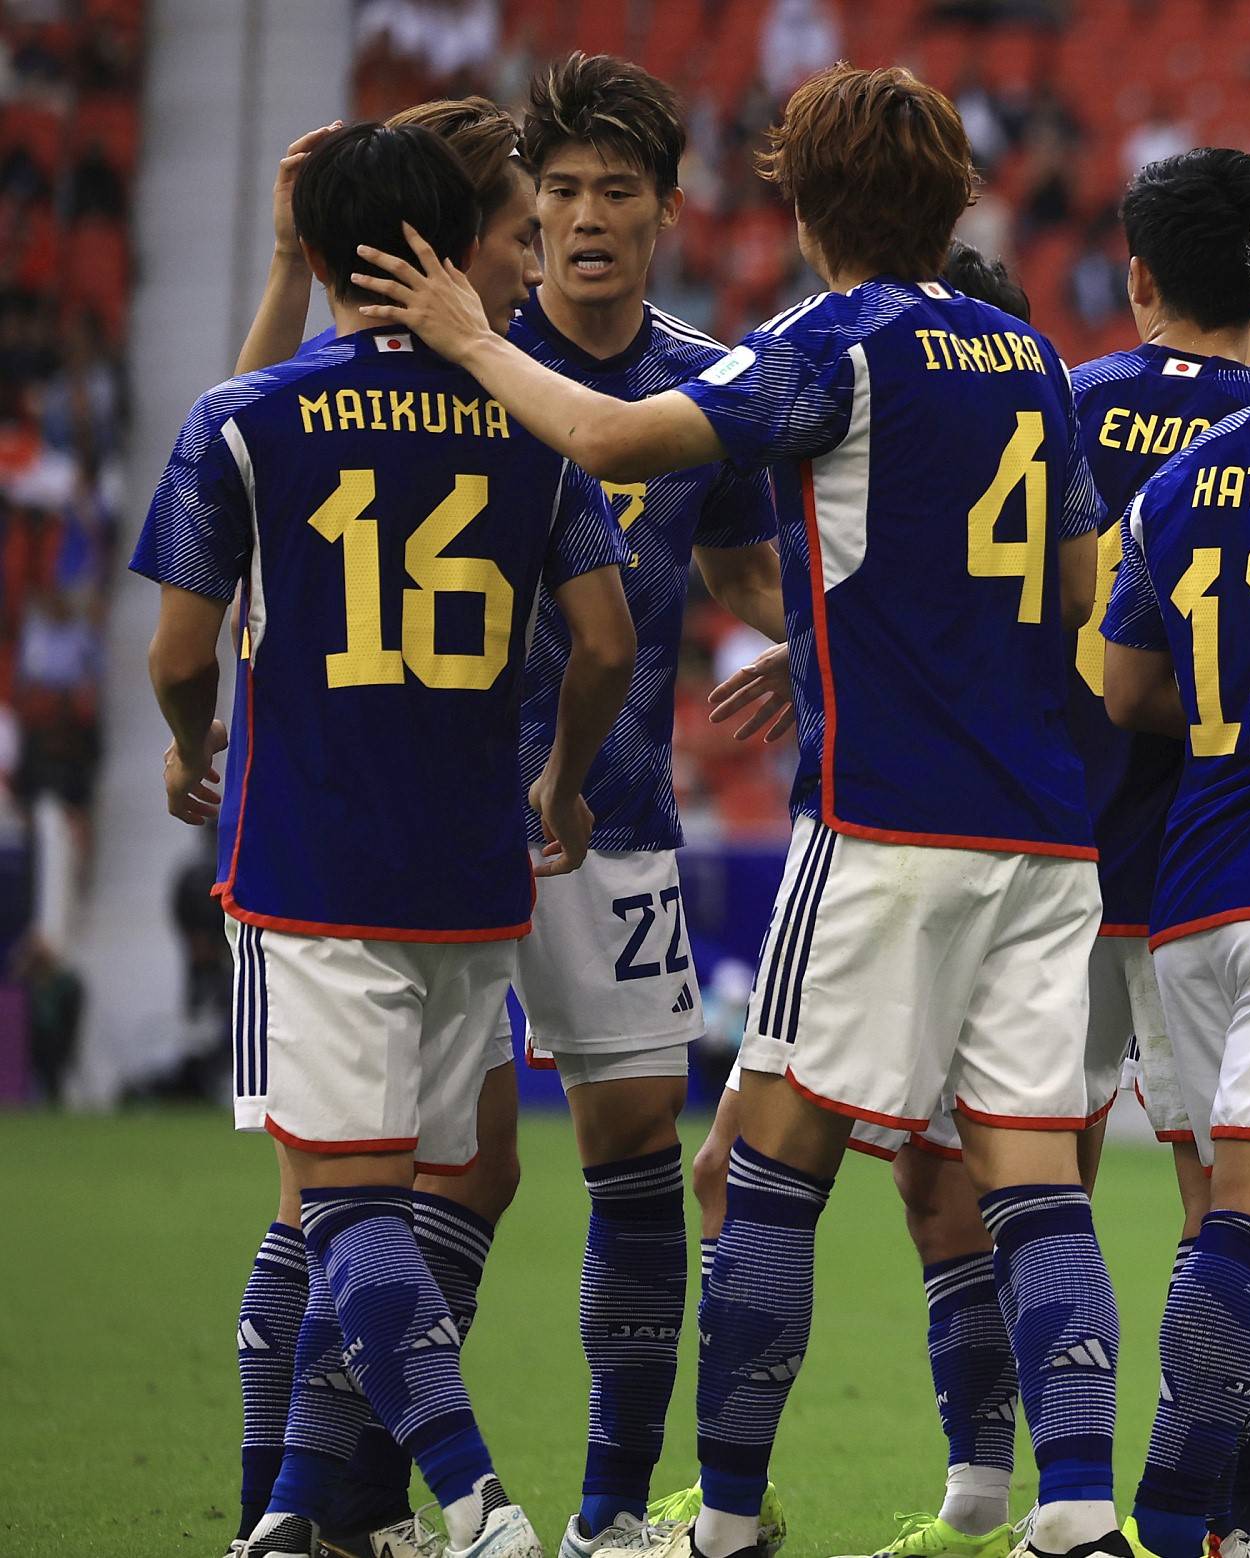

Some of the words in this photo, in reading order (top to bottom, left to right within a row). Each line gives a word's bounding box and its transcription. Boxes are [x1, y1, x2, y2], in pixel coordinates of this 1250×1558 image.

[915, 329, 1046, 376] ITAKURA
[298, 389, 511, 439] MAIKUMA
[967, 411, 1047, 624] 4
[308, 469, 514, 690] 16
[612, 885, 689, 981] 22
